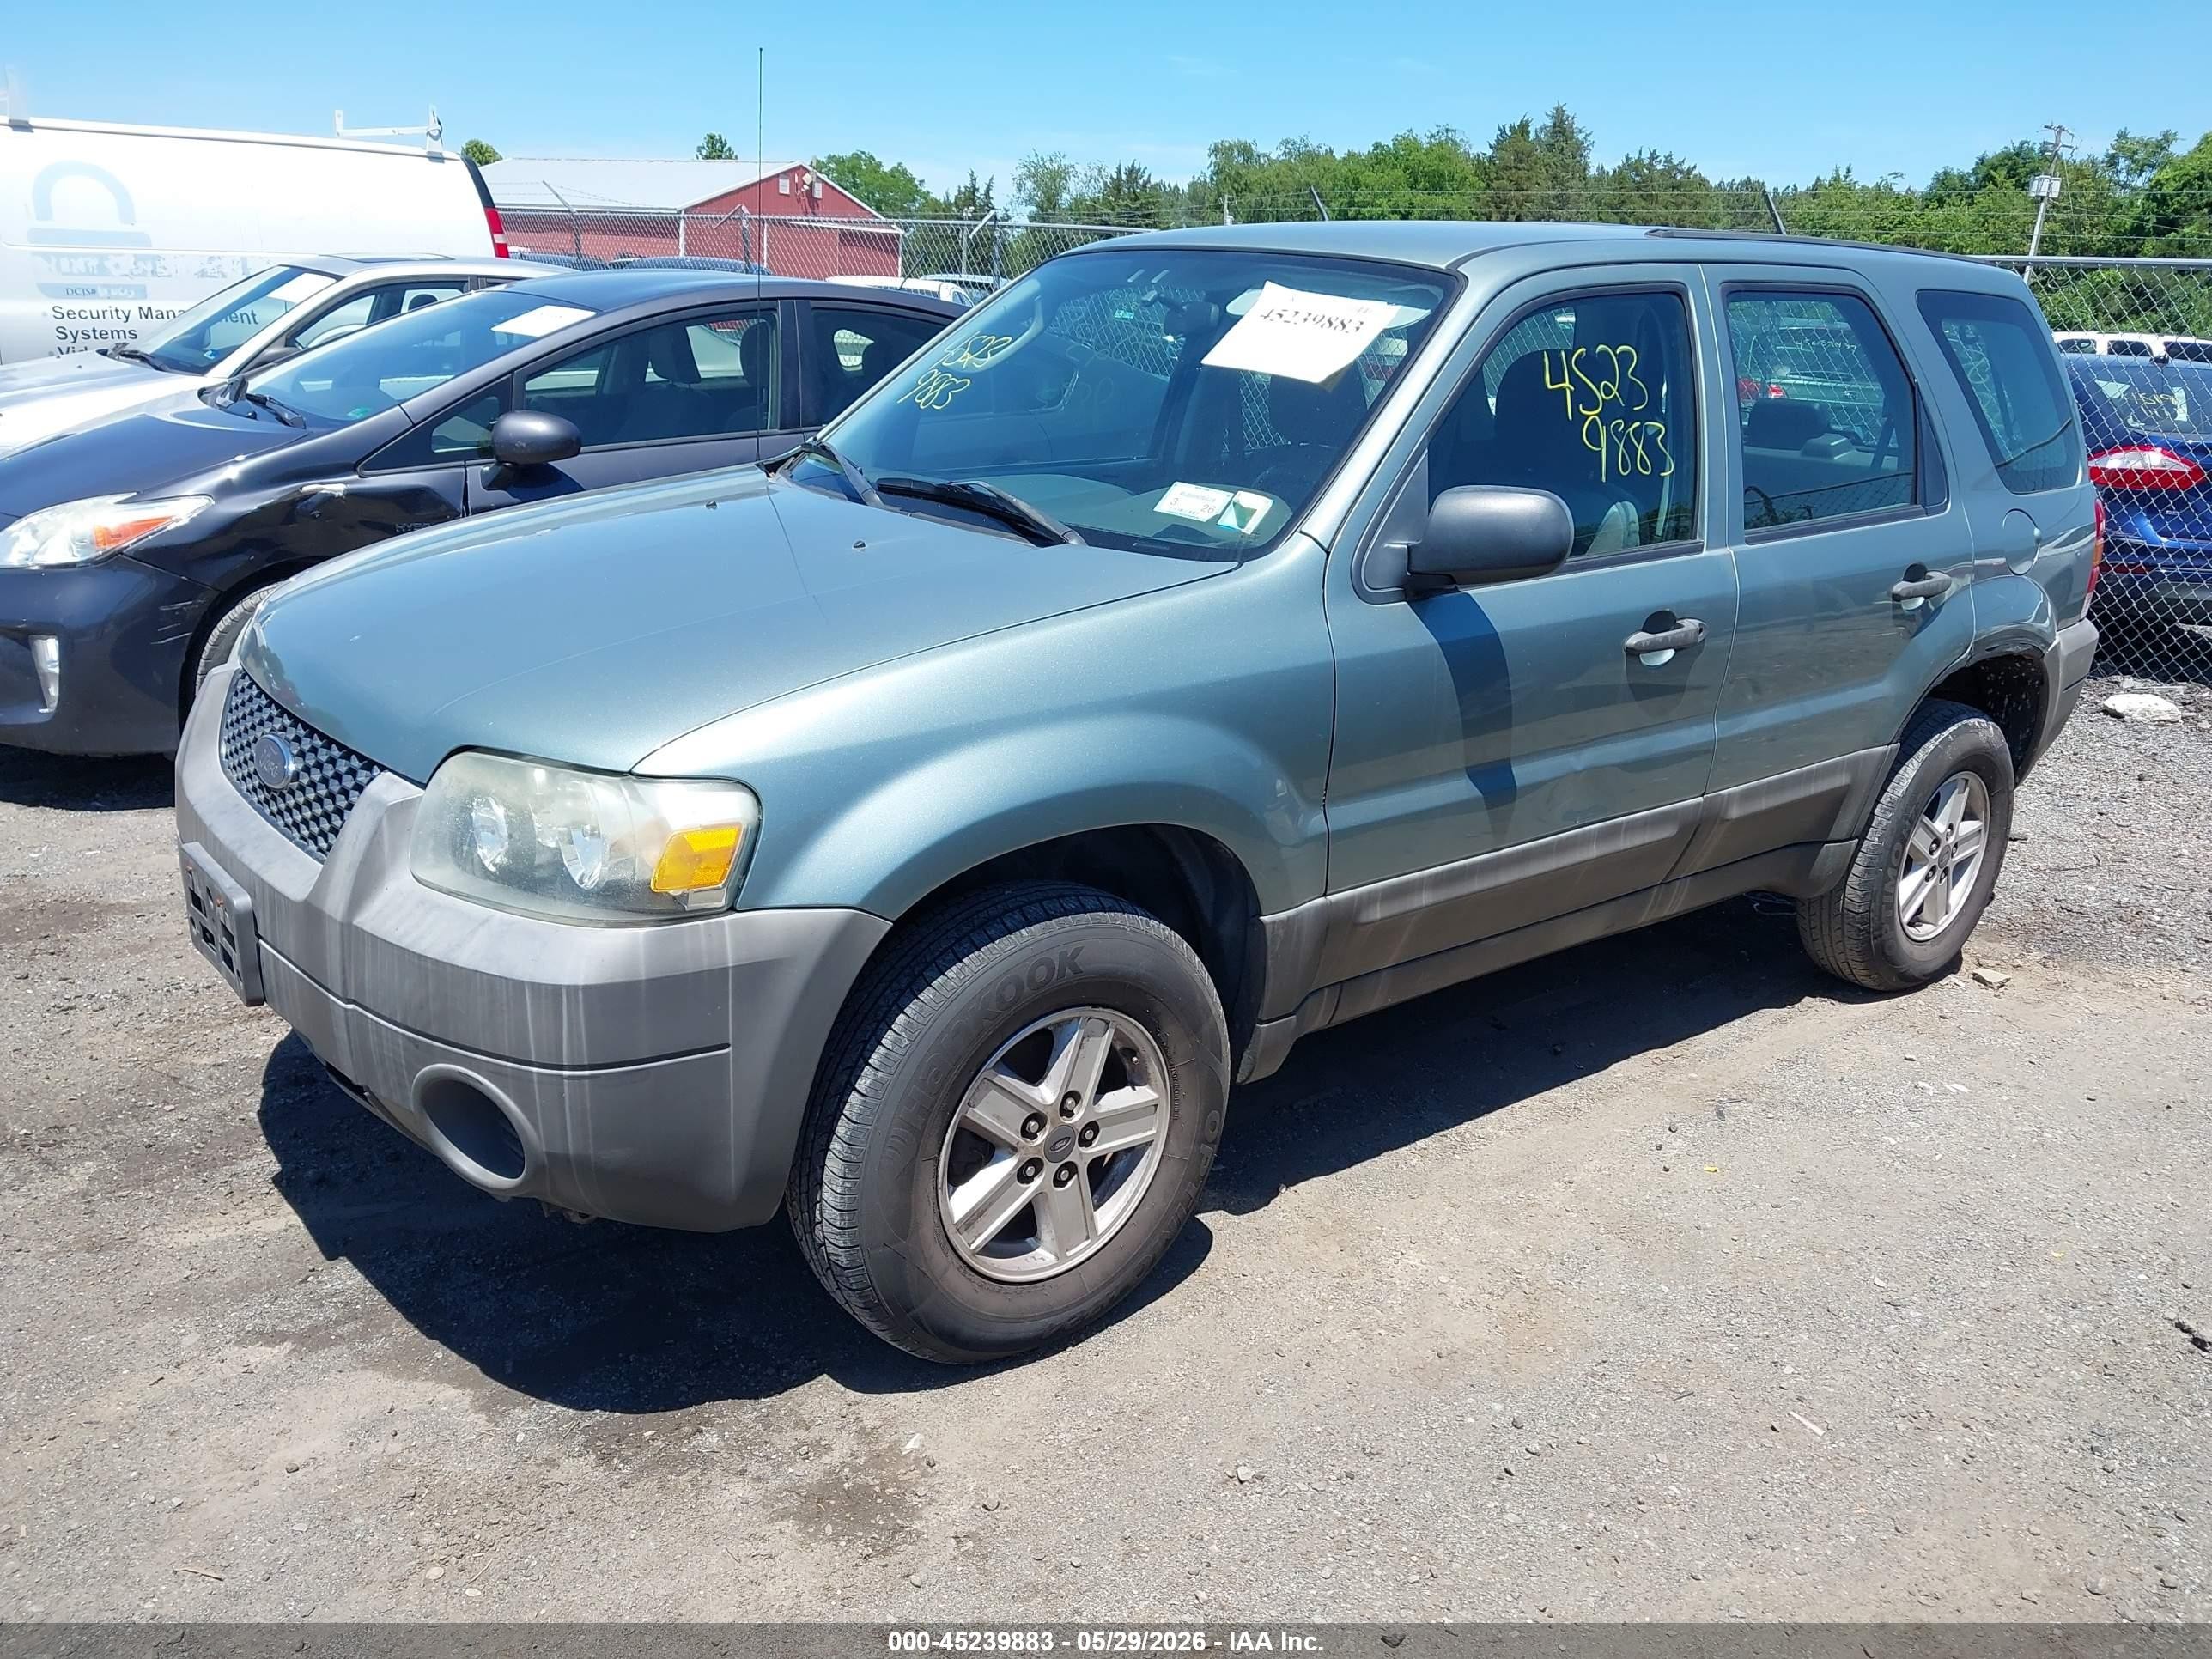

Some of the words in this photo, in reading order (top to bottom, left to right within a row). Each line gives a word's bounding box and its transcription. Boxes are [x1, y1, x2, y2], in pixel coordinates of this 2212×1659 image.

[52, 305, 131, 324] Security
[1260, 308, 1365, 334] 45239883
[55, 325, 138, 343] Systems
[896, 368, 971, 410] 9883
[1543, 344, 1648, 421] 4523
[1583, 415, 1674, 483] 9883
